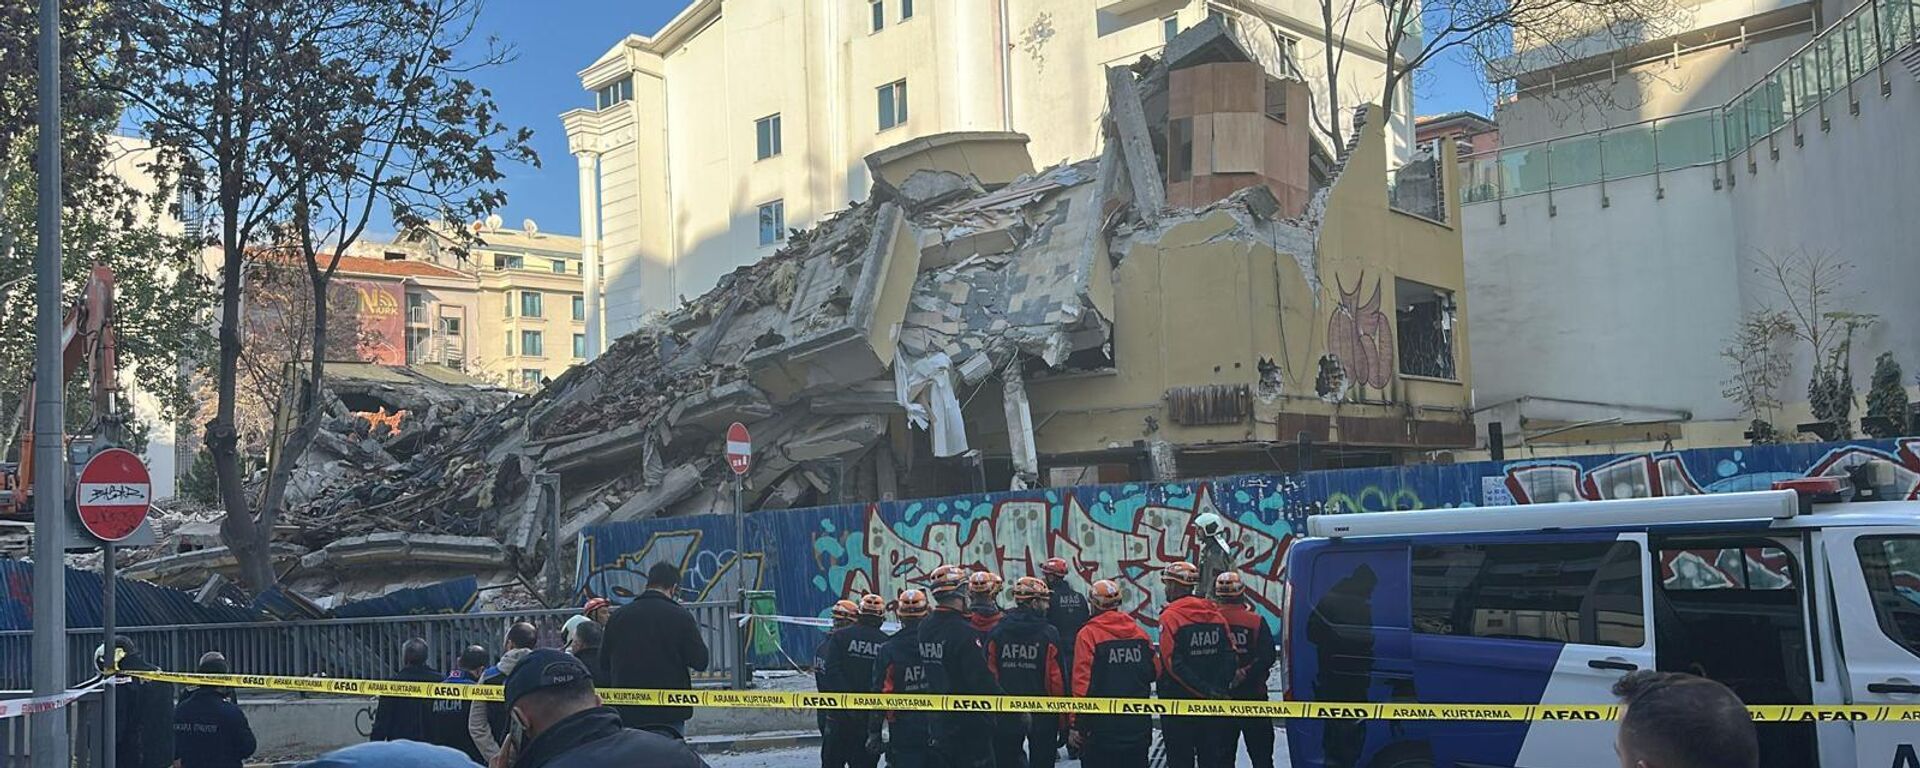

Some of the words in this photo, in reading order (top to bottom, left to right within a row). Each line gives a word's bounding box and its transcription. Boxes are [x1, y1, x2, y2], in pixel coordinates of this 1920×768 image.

[1059, 595, 1080, 604] AFAD
[1190, 631, 1220, 647] AFAD
[919, 643, 943, 659] AFAD
[1001, 643, 1038, 660] AFAD
[1108, 648, 1142, 664] AFAD
[243, 677, 265, 685] AFAD
[334, 681, 358, 691] AFAD
[368, 683, 388, 691] ARAMA
[390, 684, 421, 693] KURTARMA
[434, 686, 460, 697] AFAD
[472, 688, 494, 697] ARAMA
[613, 692, 652, 701] KURTARMA
[667, 694, 699, 704] AFAD
[713, 695, 740, 703] ARAMA
[743, 695, 785, 704] KURTARMA
[803, 697, 837, 706] AFAD
[853, 698, 882, 706] ARAMA
[886, 698, 933, 707] KURTARMA
[953, 700, 992, 709] AFAD
[1009, 700, 1042, 709] ARAMA
[1046, 701, 1100, 711] KURTARMA
[1122, 704, 1166, 713] AFAD
[1187, 705, 1225, 714] ARAMA
[1229, 705, 1290, 715] KURTARMA
[1317, 708, 1368, 717] AFAD
[1392, 709, 1436, 718] ARAMA
[1442, 709, 1512, 719] KURTARMA
[1541, 711, 1600, 720] AFAD
[1801, 711, 1867, 721] AFAD
